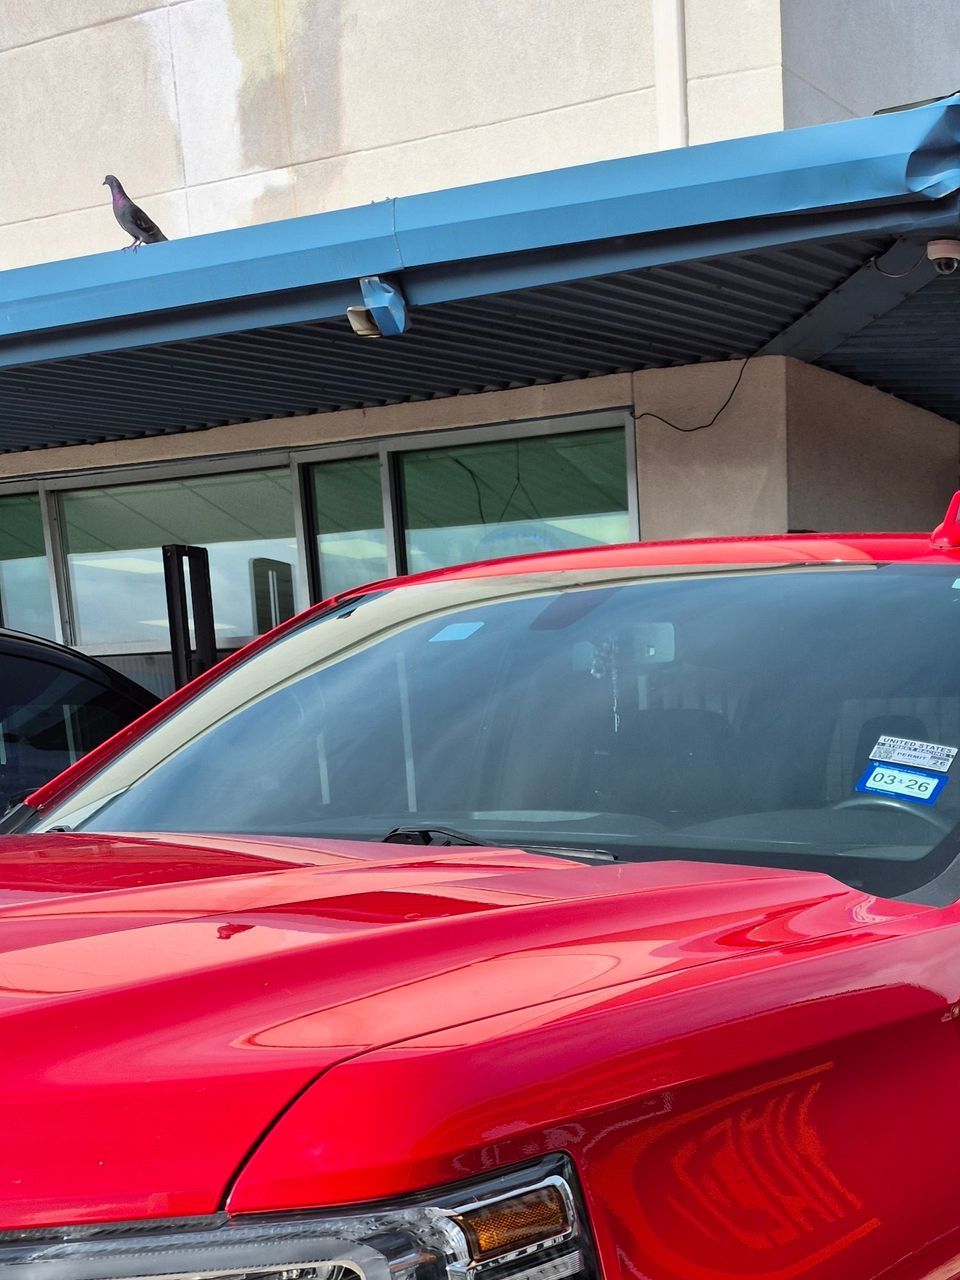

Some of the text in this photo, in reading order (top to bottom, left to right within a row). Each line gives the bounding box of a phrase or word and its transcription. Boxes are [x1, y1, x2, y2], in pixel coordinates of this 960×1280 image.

[882, 737, 916, 747] UNITED
[919, 743, 952, 754] STATES
[897, 752, 927, 761] PERMIT
